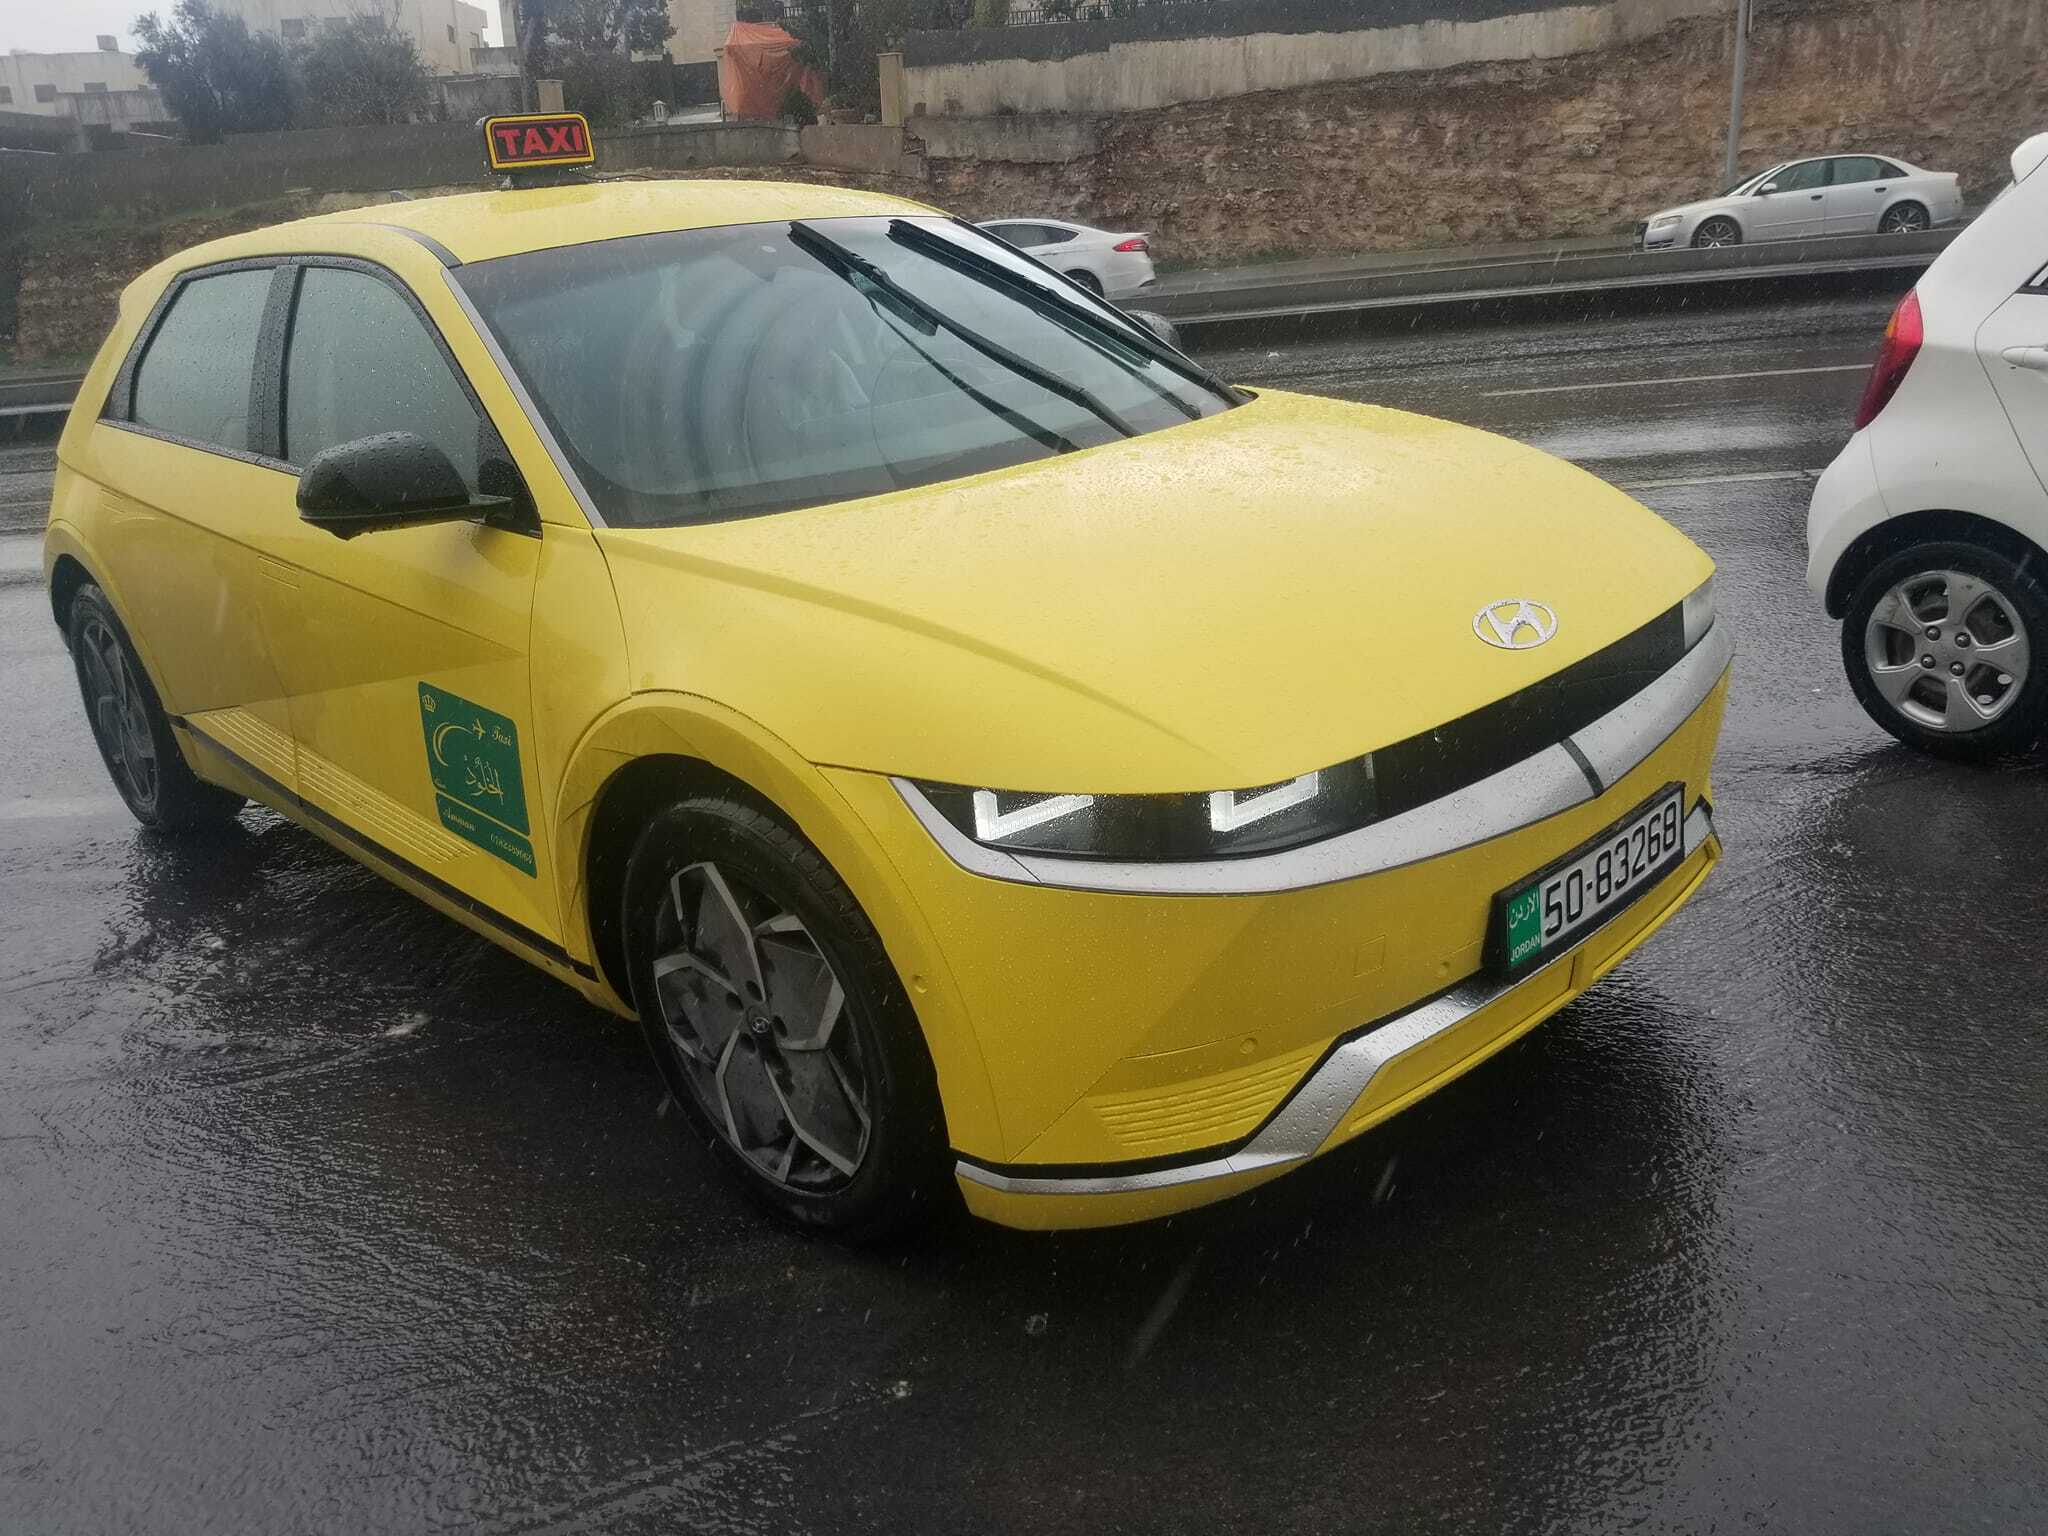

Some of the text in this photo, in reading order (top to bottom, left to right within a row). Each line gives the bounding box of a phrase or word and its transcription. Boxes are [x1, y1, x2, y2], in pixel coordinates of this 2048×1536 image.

[496, 126, 584, 156] TAXI
[1545, 800, 1677, 938] 50-83268
[1510, 931, 1540, 962] JORDAN
